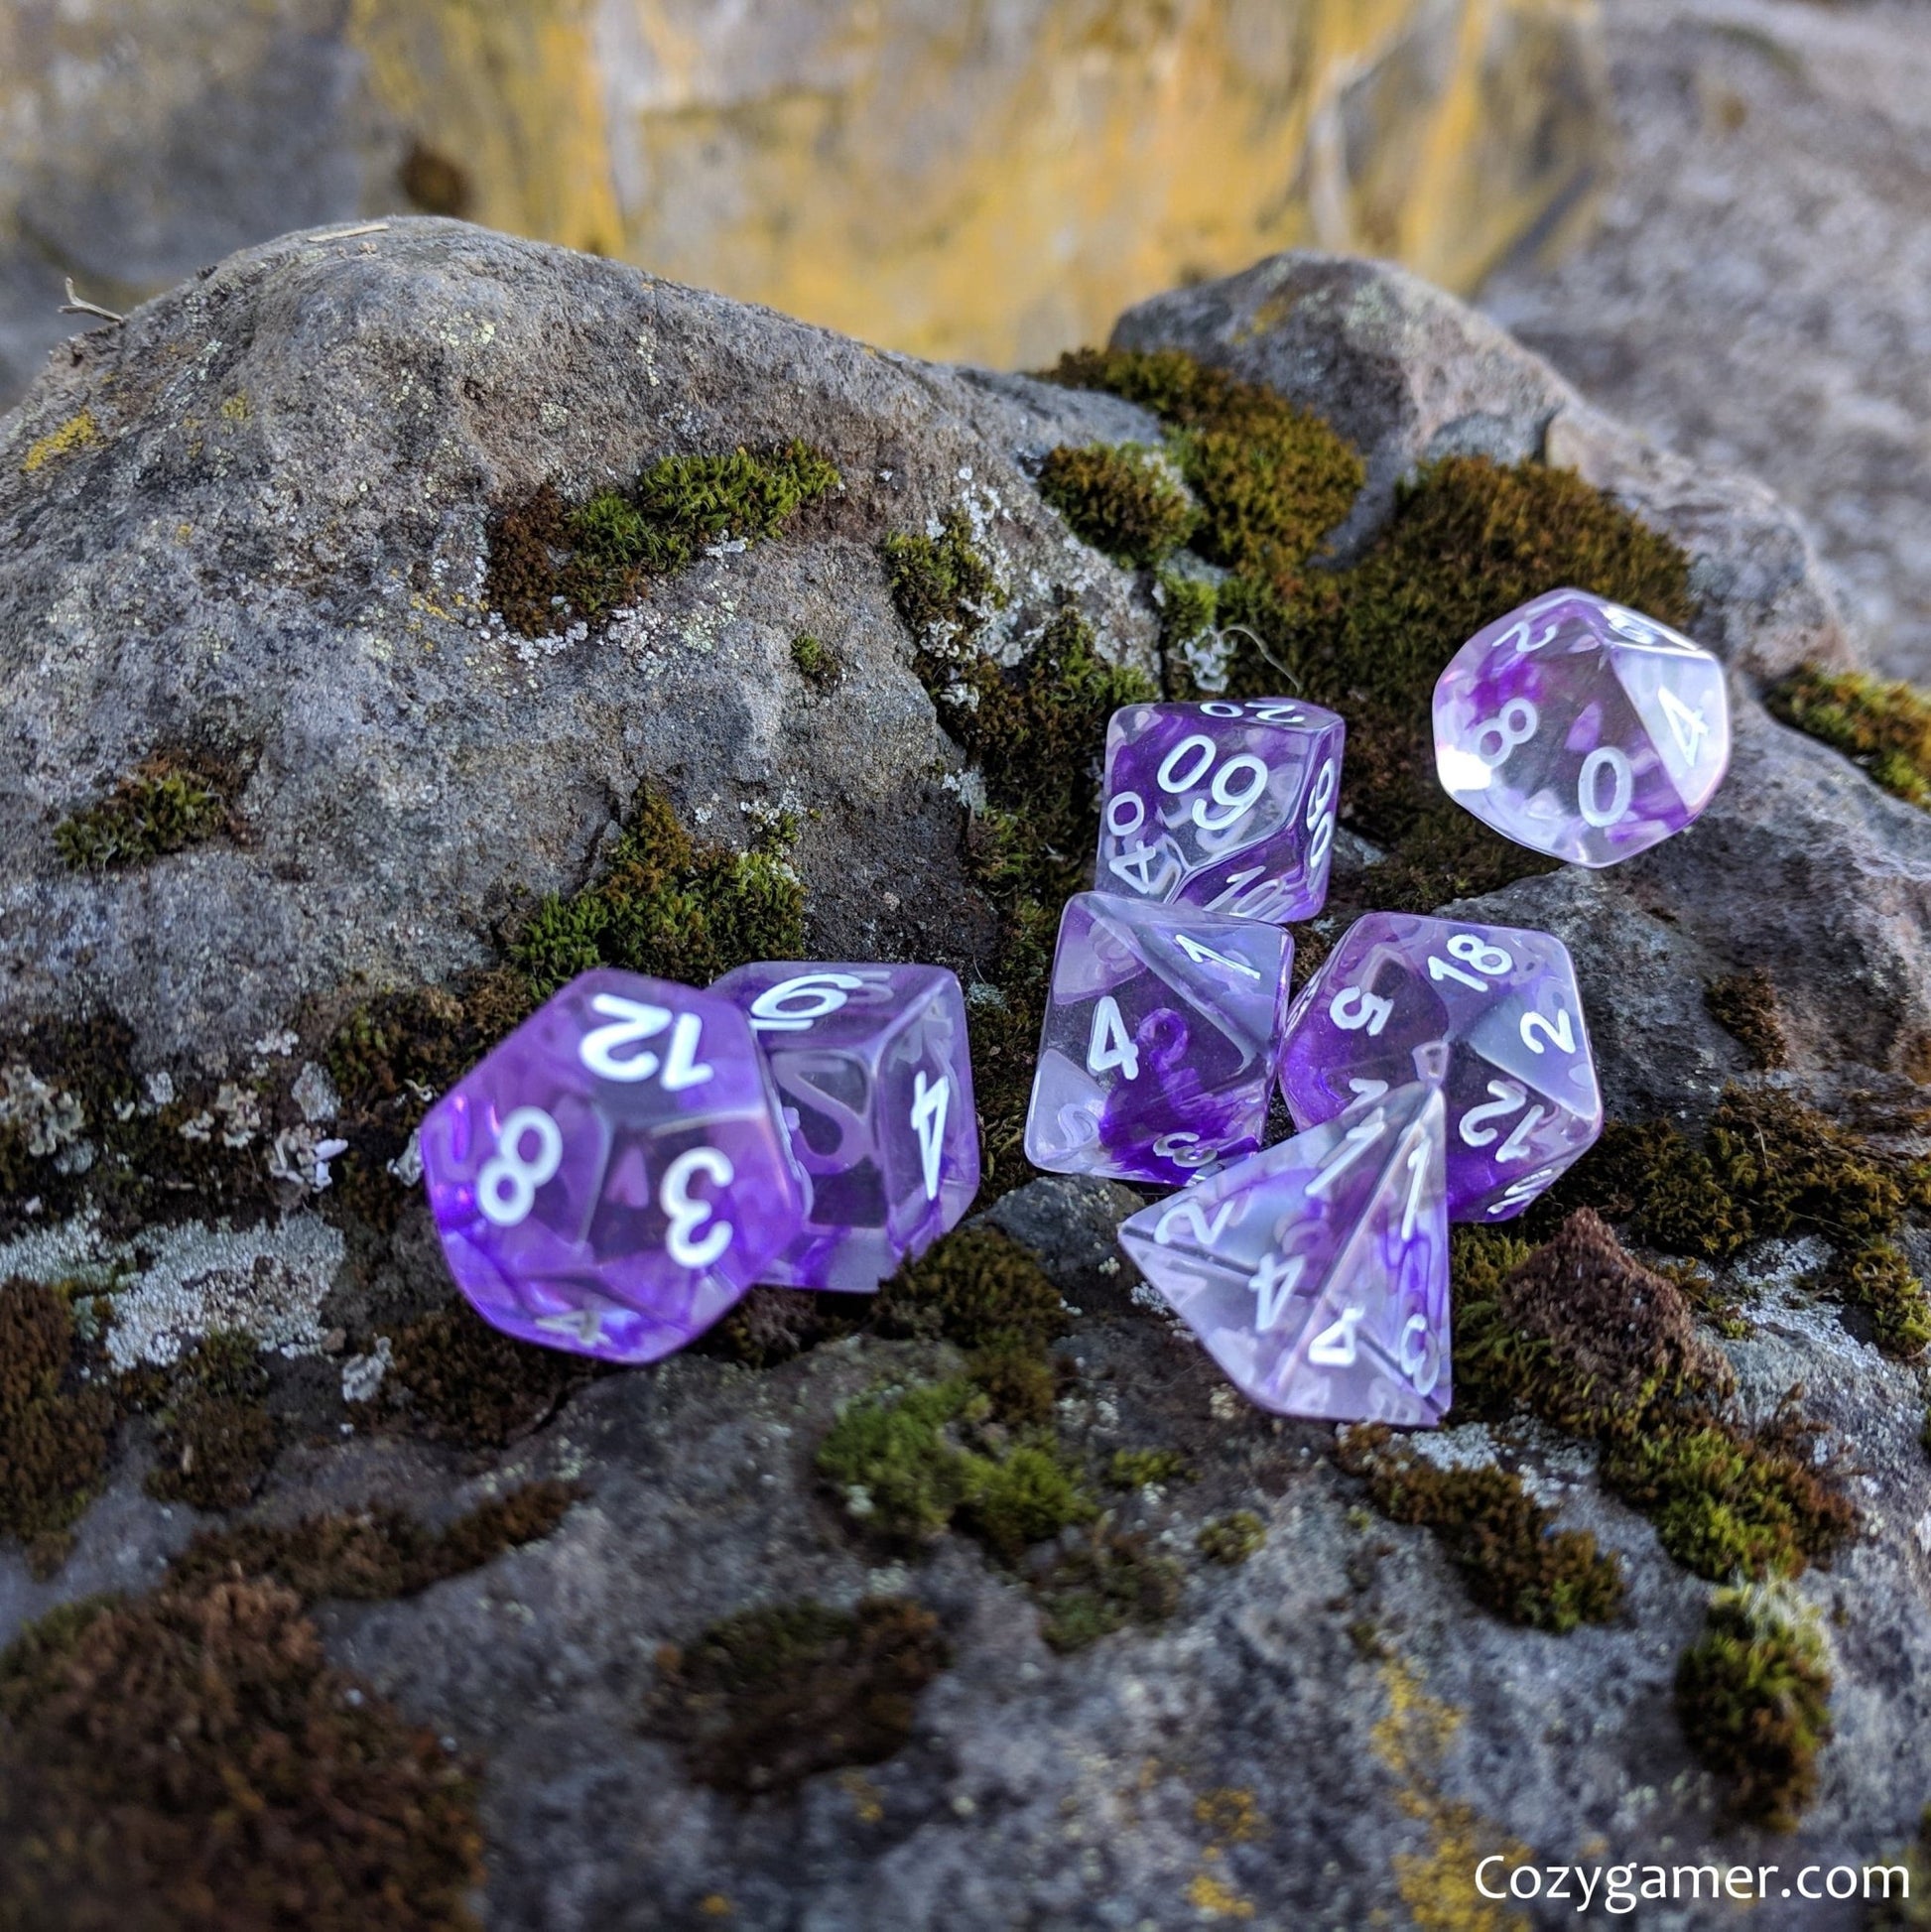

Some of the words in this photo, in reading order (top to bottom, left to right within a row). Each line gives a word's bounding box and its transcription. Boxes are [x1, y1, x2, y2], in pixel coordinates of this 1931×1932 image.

[1477, 698, 1537, 768] 8
[1658, 686, 1709, 766] 4
[1578, 746, 1632, 828] 0
[1107, 791, 1156, 894] 40
[1175, 935, 1260, 980] 1
[1428, 934, 1513, 992] 18
[579, 994, 713, 1091] 12
[1088, 995, 1139, 1081] 4
[1330, 985, 1394, 1036] 5
[1519, 1008, 1576, 1054] 2
[911, 1070, 950, 1201] 4
[1305, 1120, 1385, 1196] 1
[1460, 1080, 1545, 1163] 12
[475, 1105, 563, 1226] 8
[1401, 1138, 1431, 1240] 1
[661, 1147, 733, 1268] 3
[1248, 1251, 1306, 1333] 4
[1308, 1305, 1365, 1366] 4
